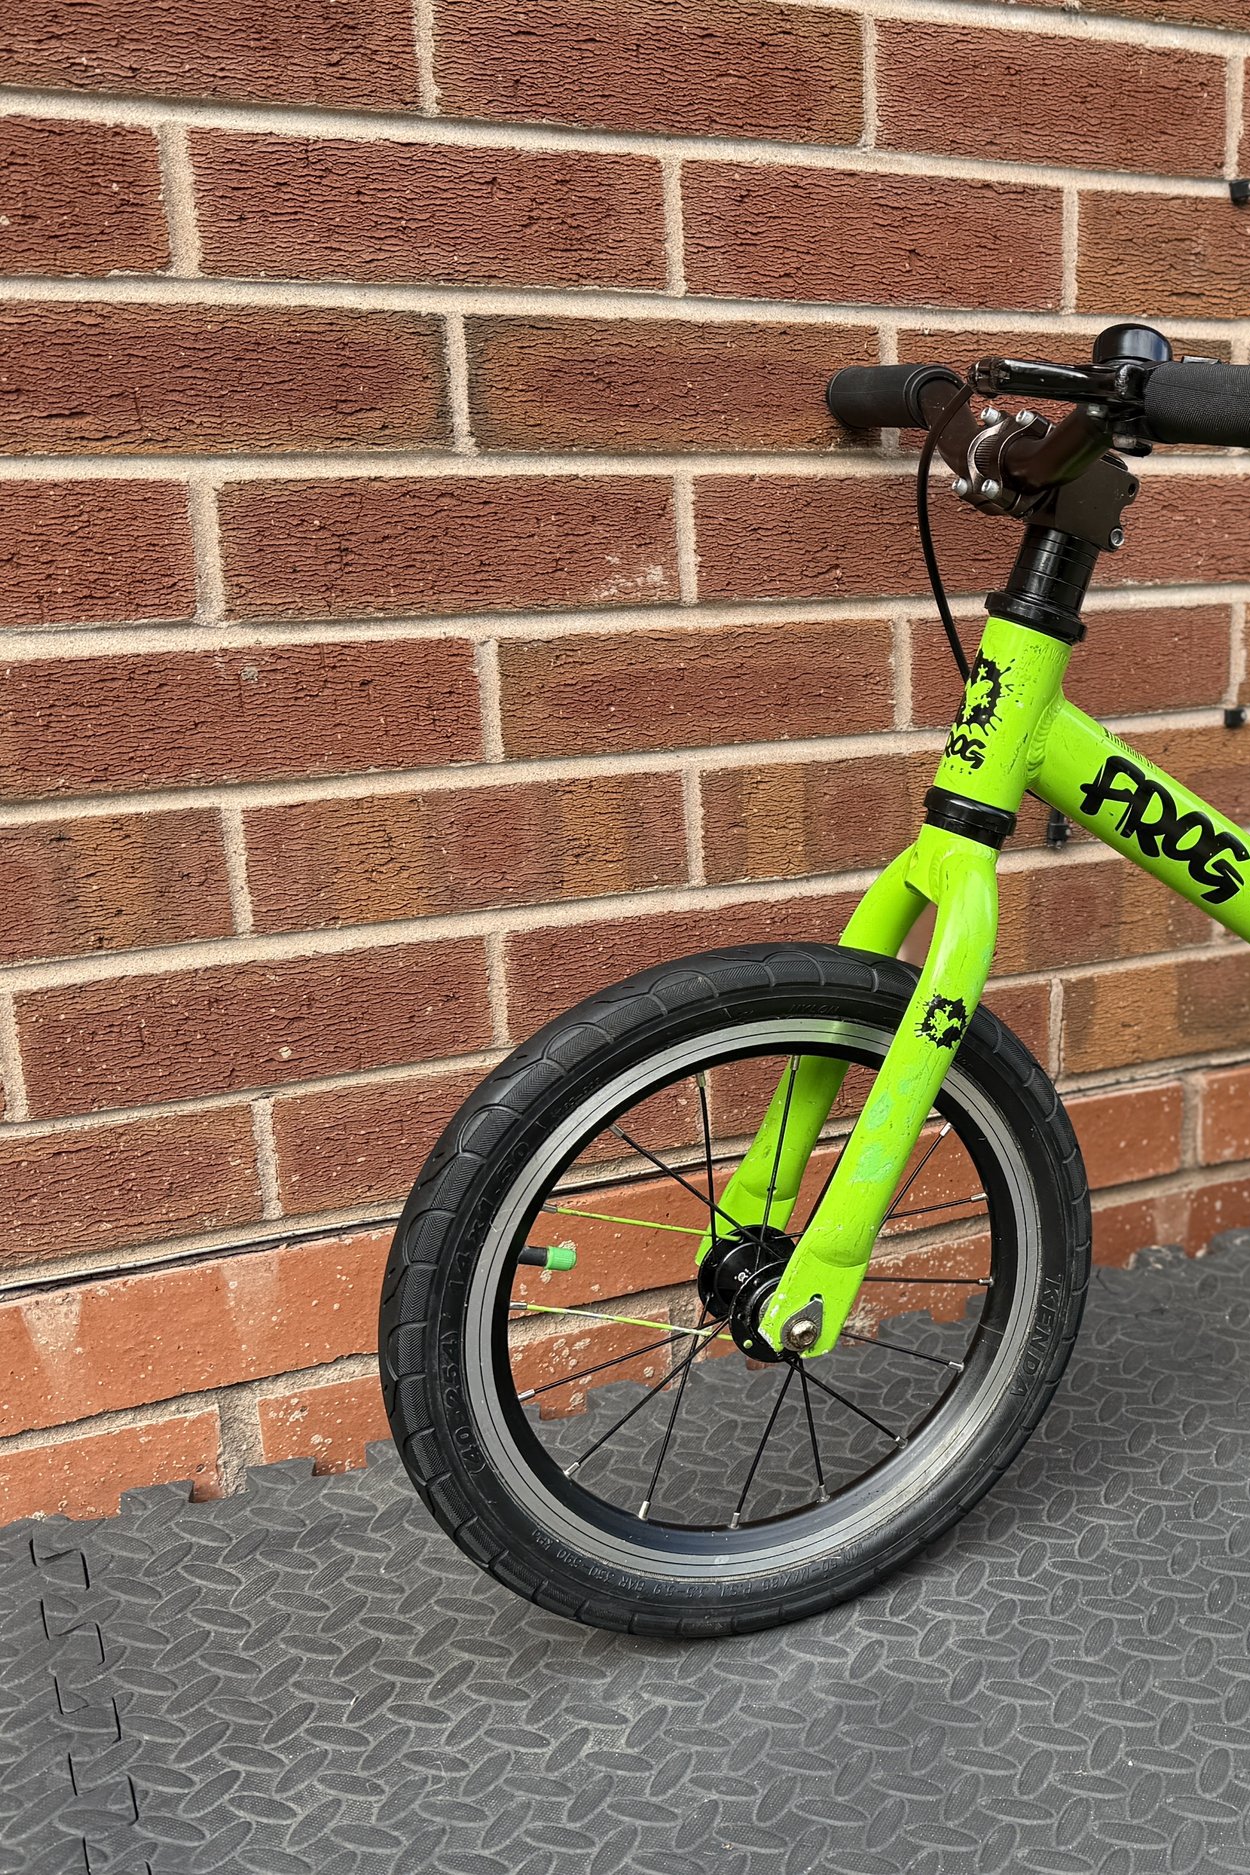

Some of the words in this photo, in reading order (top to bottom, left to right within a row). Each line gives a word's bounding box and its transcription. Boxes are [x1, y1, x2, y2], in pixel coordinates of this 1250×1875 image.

[944, 730, 987, 770] ROG
[1079, 755, 1250, 905] FROG
[1008, 1272, 1064, 1399] KENDA
[617, 1573, 645, 1592] BAR
